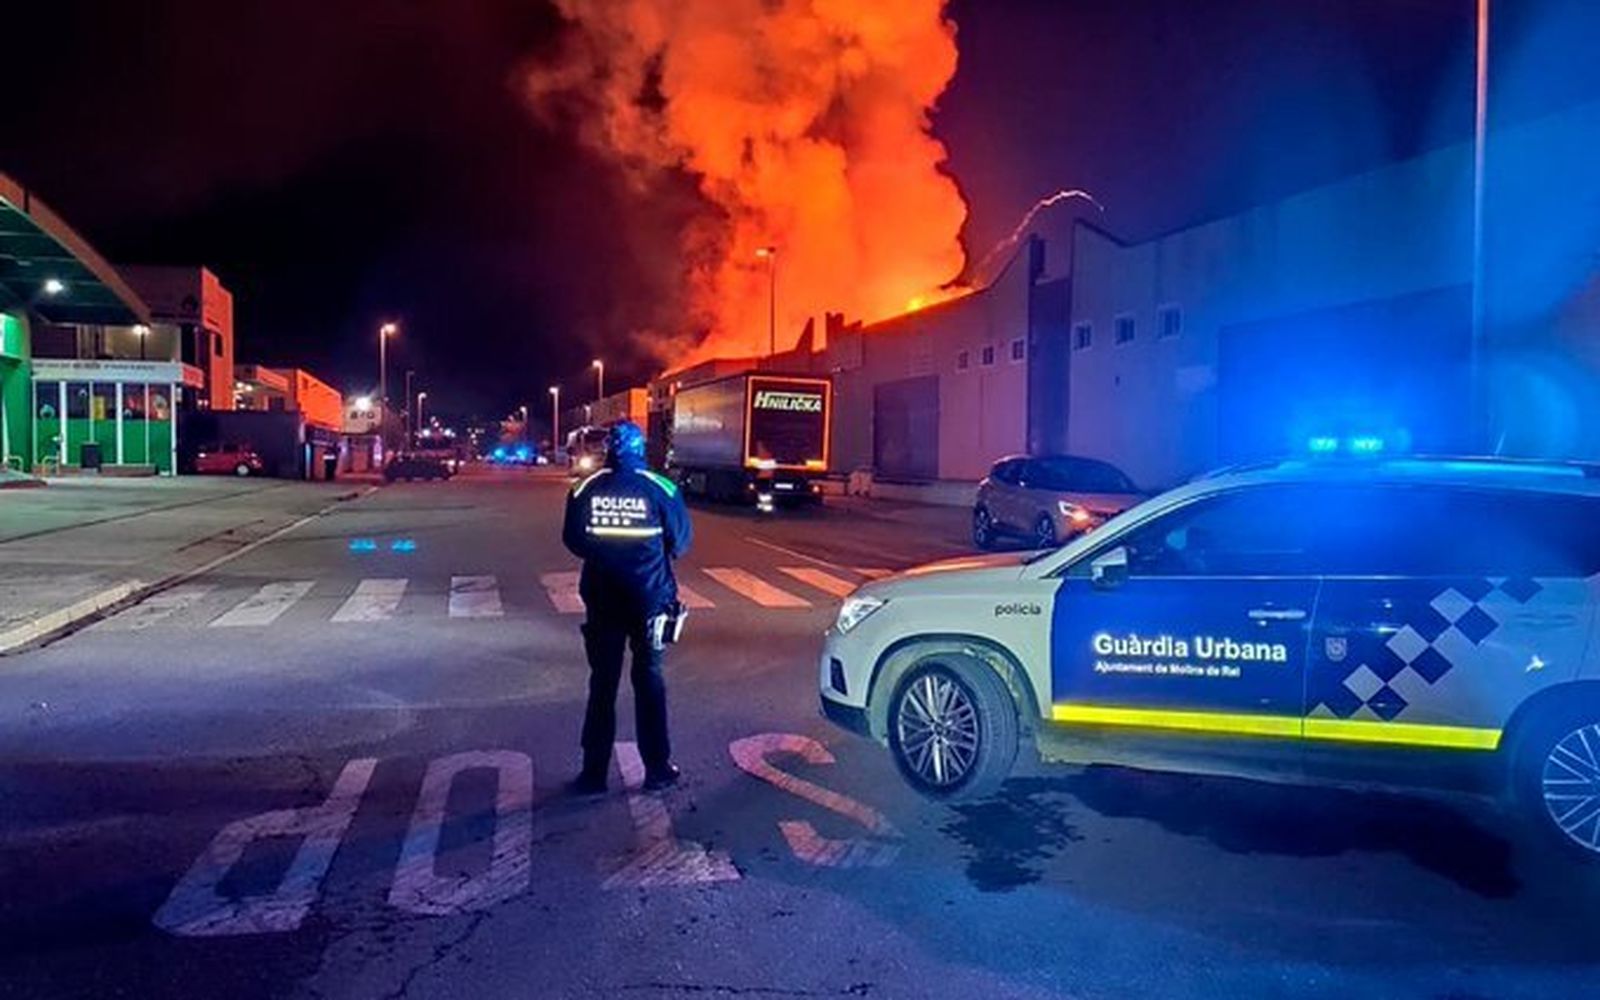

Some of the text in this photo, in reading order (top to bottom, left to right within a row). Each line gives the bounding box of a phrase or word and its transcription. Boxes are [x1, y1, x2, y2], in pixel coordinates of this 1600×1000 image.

[1093, 633, 1287, 662] Guàrdia Urbana
[152, 732, 904, 937] STOP
